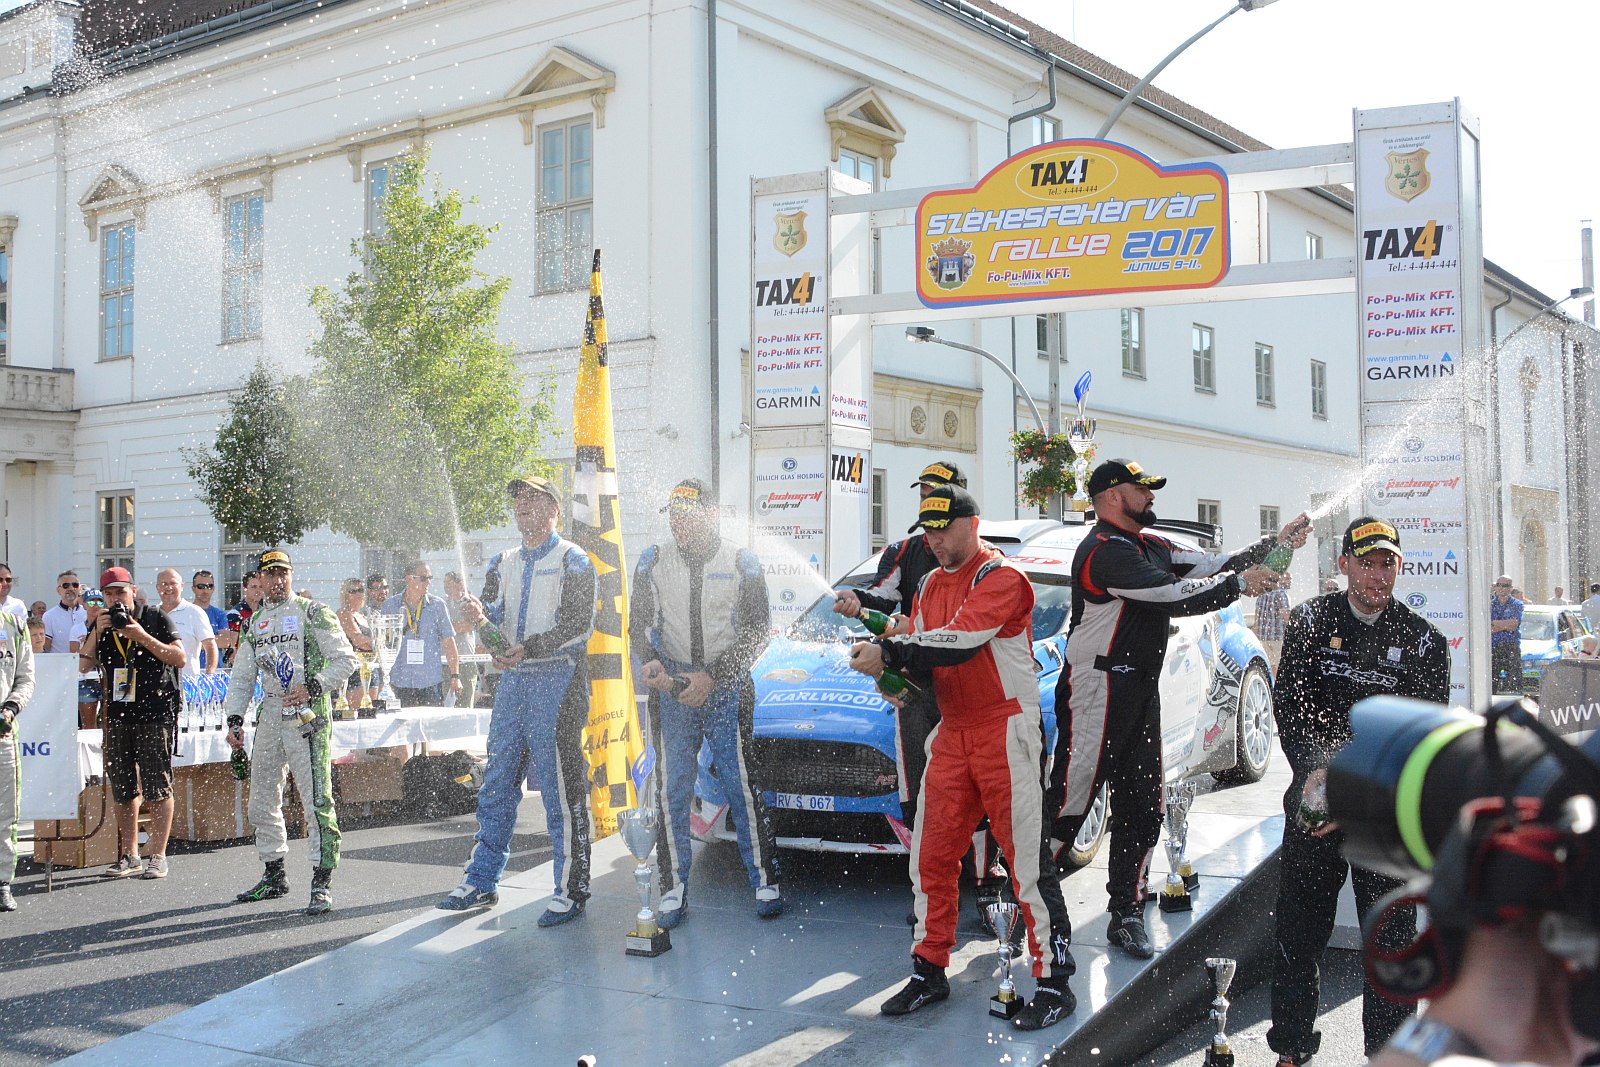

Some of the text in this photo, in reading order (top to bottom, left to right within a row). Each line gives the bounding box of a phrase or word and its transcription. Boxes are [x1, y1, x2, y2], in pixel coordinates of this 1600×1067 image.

[1048, 185, 1098, 196] Tel.: 4-444-444
[1121, 225, 1216, 260] 2017
[1388, 259, 1457, 272] Tel.: 4-444-444
[987, 267, 1071, 283] Fo-Pu-Mix KFT.
[1367, 290, 1454, 305] Fo-Pu-Mix KFT.
[773, 305, 825, 317] Tel.: 4-444-444
[1367, 306, 1454, 321] Fo-Pu-Mix KFT.
[1368, 323, 1455, 338] Fo-Pu-Mix KFT.
[757, 332, 823, 344] Fo-Pu-Mix KFT.
[757, 346, 823, 358] Fo-Pu-Mix KFT.
[1367, 353, 1429, 363] www.garmin.hu
[757, 359, 823, 372] Fo-Pu-Mix KFT.
[1367, 363, 1454, 380] GARMIN
[756, 395, 821, 409] GARMIN
[831, 394, 856, 407] Fo-Pu-Mix
[831, 409, 856, 420] Fo-Pu-Mix
[780, 473, 795, 481] GLAS
[796, 472, 825, 480] HOLDING
[1401, 561, 1458, 576] RMIN
[1426, 611, 1464, 619] HOLDING
[768, 690, 884, 707] KARLWOOD
[809, 796, 831, 809] 067
